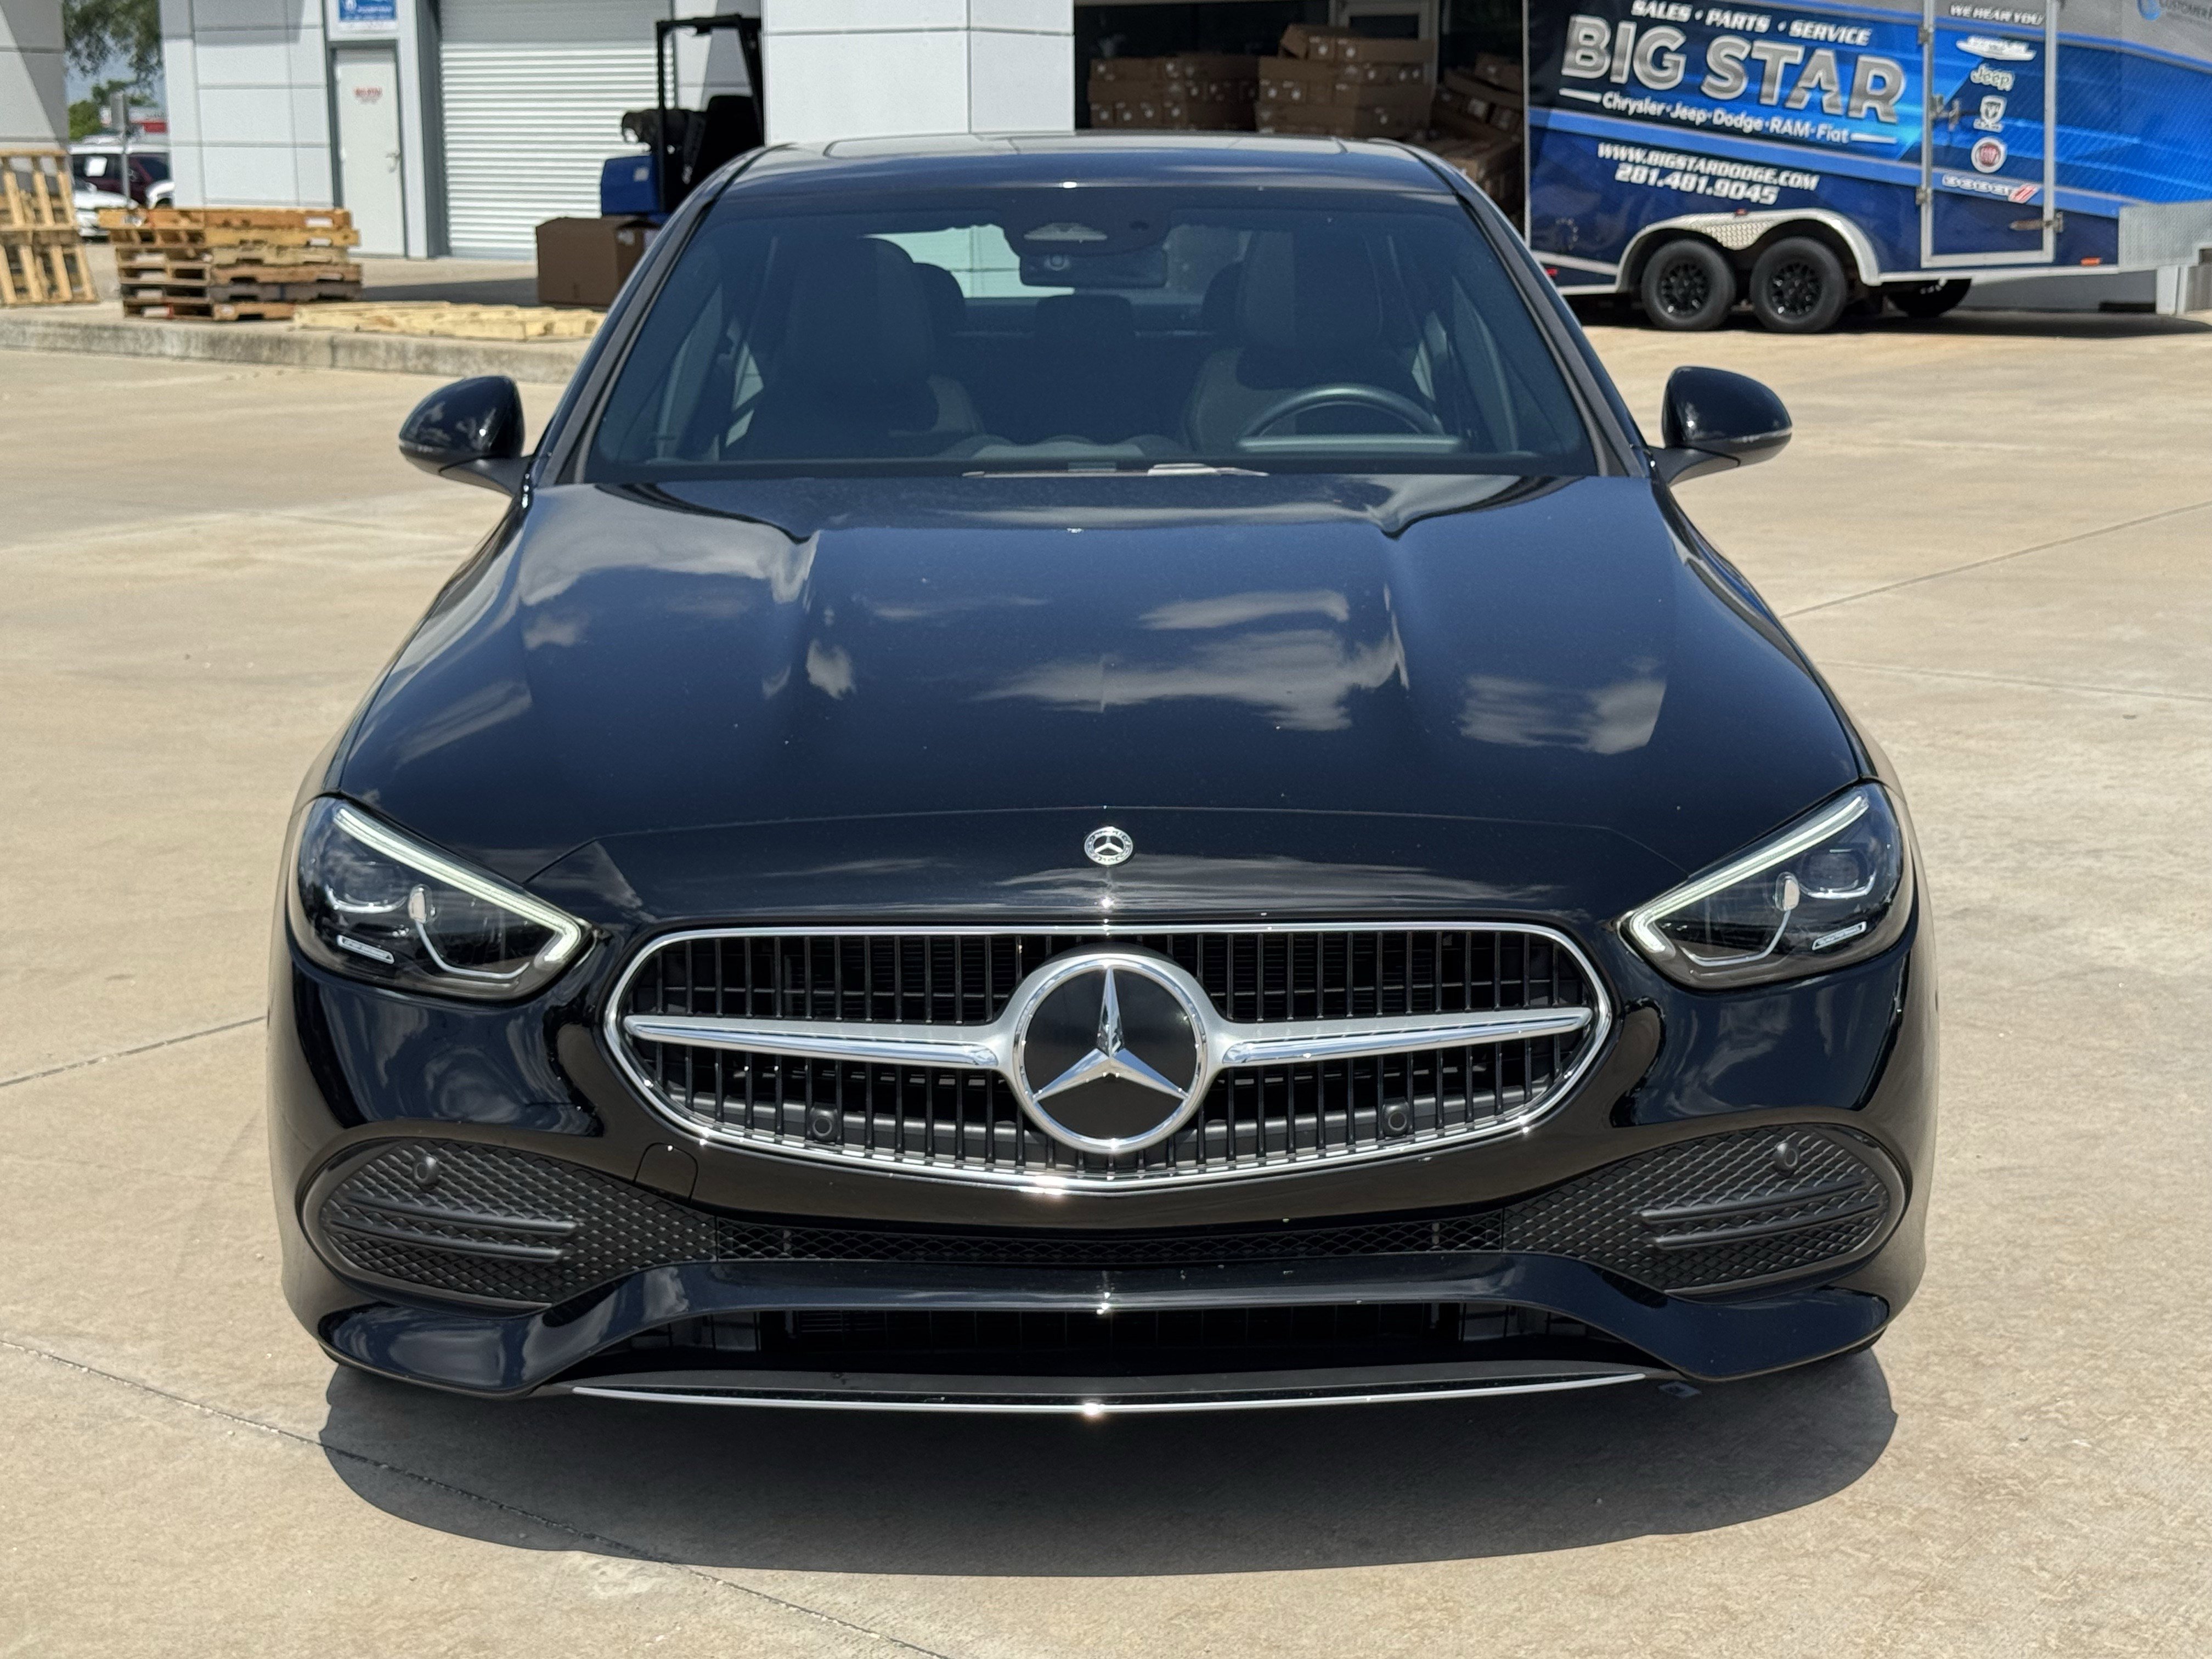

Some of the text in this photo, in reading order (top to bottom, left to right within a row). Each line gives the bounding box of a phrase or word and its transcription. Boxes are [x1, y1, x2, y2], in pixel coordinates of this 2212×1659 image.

[1632, 0, 1871, 46] SALES PARTS SERVICE
[1950, 4, 2044, 25] WE HEAR YOU
[1561, 14, 1904, 123] BIG STAR
[1973, 65, 2011, 88] Jeep
[1603, 91, 1849, 143] Chrysler Jeep Dodge RAM Fiat
[1597, 142, 1820, 190] WWW.BIGSTARDODGE.COM
